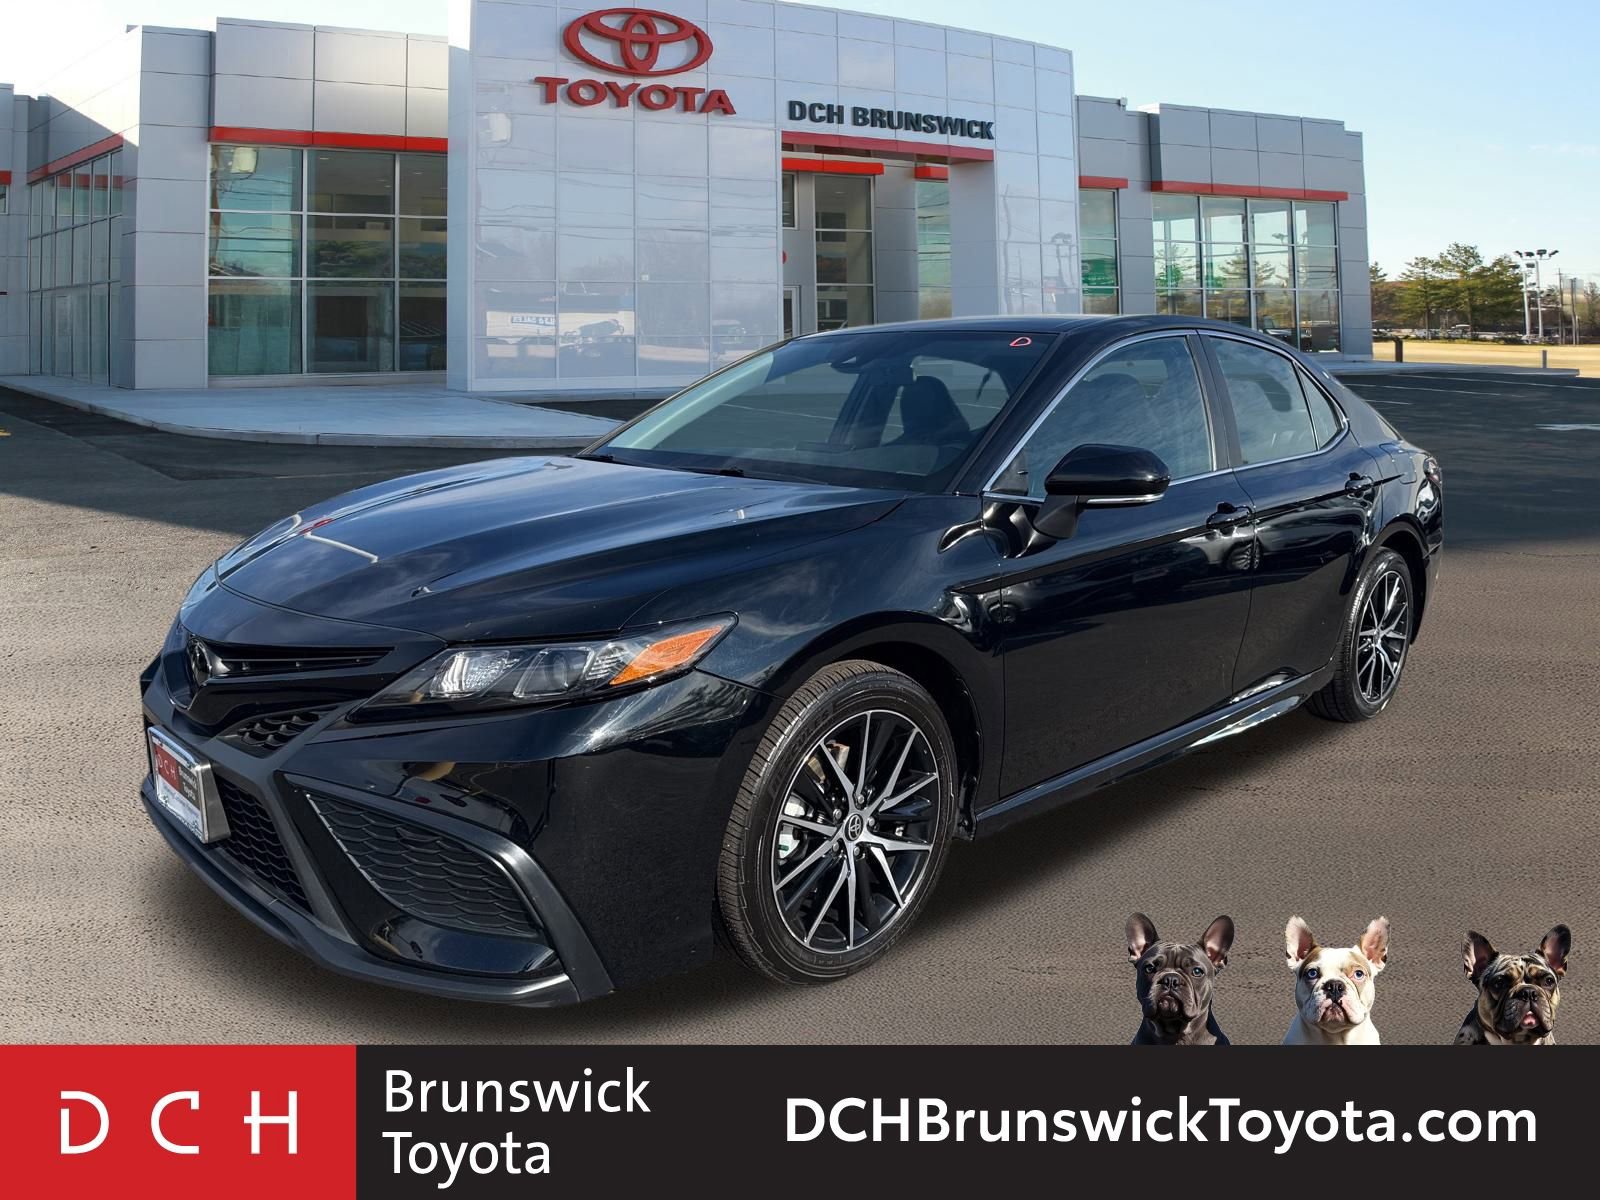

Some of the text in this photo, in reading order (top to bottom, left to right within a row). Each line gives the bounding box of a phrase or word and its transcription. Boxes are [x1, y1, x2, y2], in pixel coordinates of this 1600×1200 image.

[534, 76, 736, 115] TOYOTA
[788, 100, 995, 140] DCH BRUNSWICK
